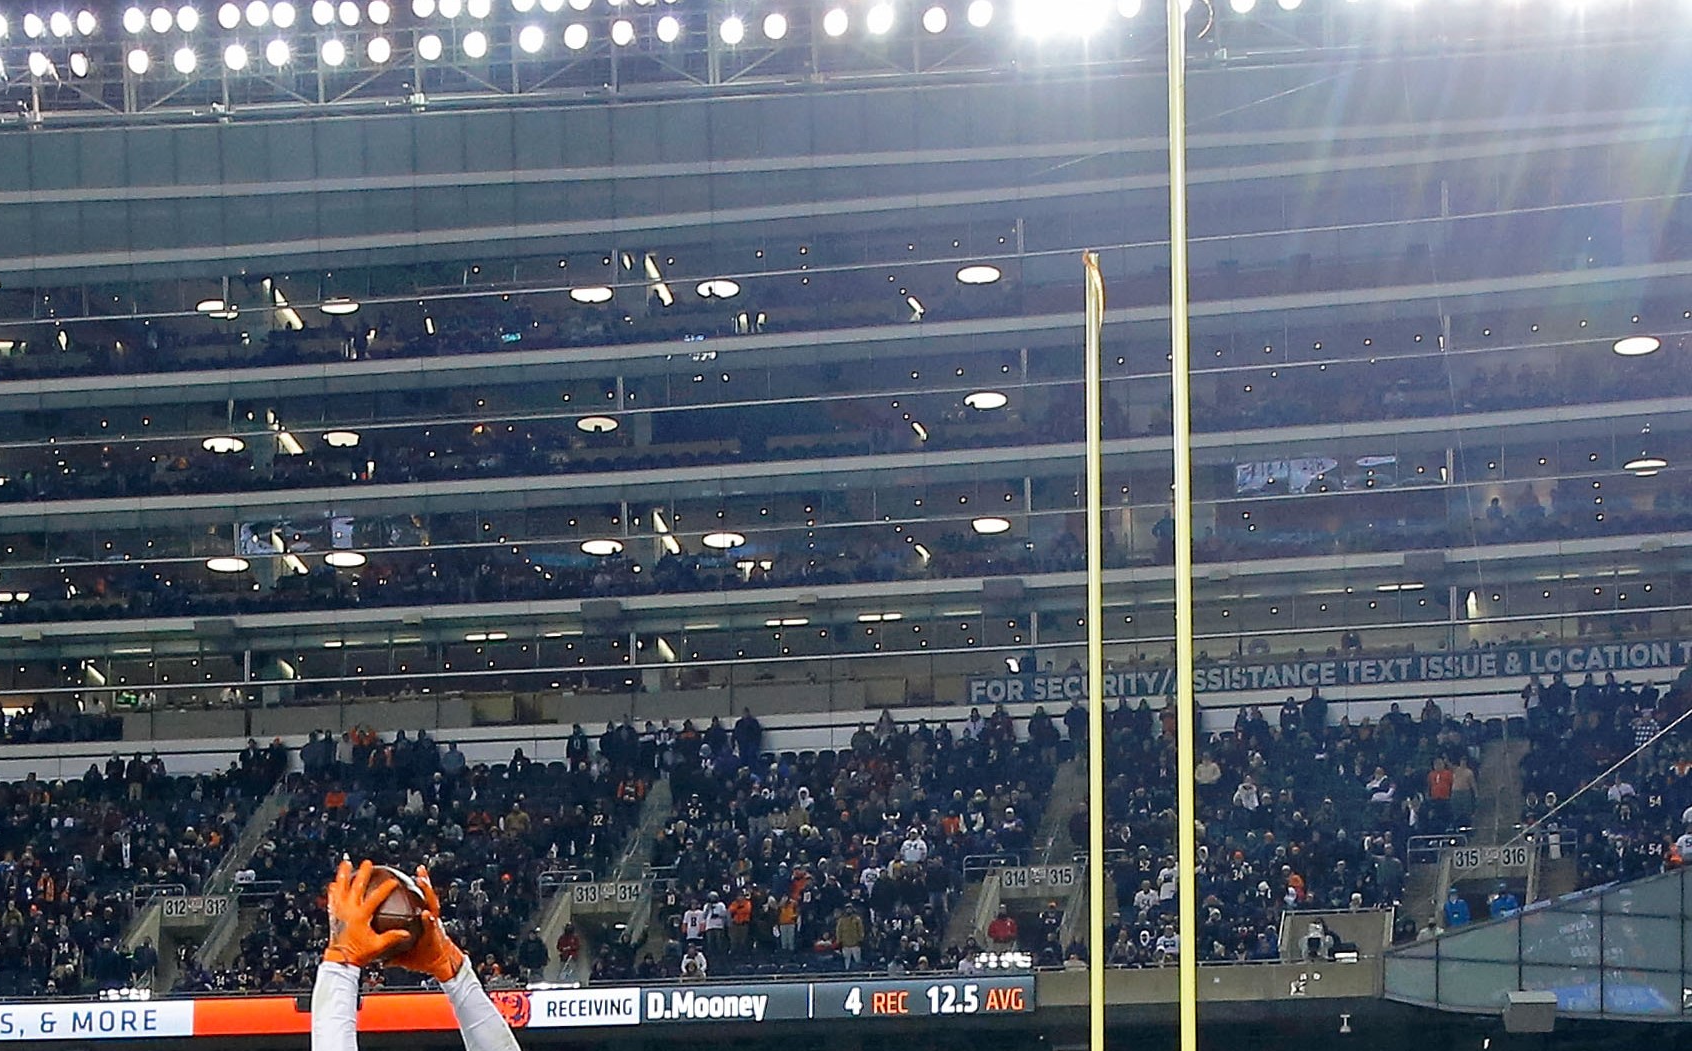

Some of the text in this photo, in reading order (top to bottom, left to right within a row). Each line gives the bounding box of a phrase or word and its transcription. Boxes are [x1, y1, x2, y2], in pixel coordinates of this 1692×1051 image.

[971, 678, 1024, 701] FOR
[1343, 658, 1412, 682] TEXT
[1420, 654, 1496, 679] ISSUE
[1504, 651, 1521, 673] &
[1530, 642, 1670, 674] LOCATION
[1455, 851, 1478, 866] 315
[1503, 848, 1526, 864] 316
[1005, 870, 1026, 886] 314
[1050, 868, 1072, 884] 315
[576, 886, 596, 902] 313
[619, 884, 640, 900] 314
[165, 901, 185, 915] 312
[546, 985, 1024, 1022] RECEIVING D.Mooney 4 REC 12.5 AVG
[39, 1011, 57, 1033] &
[71, 1008, 158, 1033] MORE
